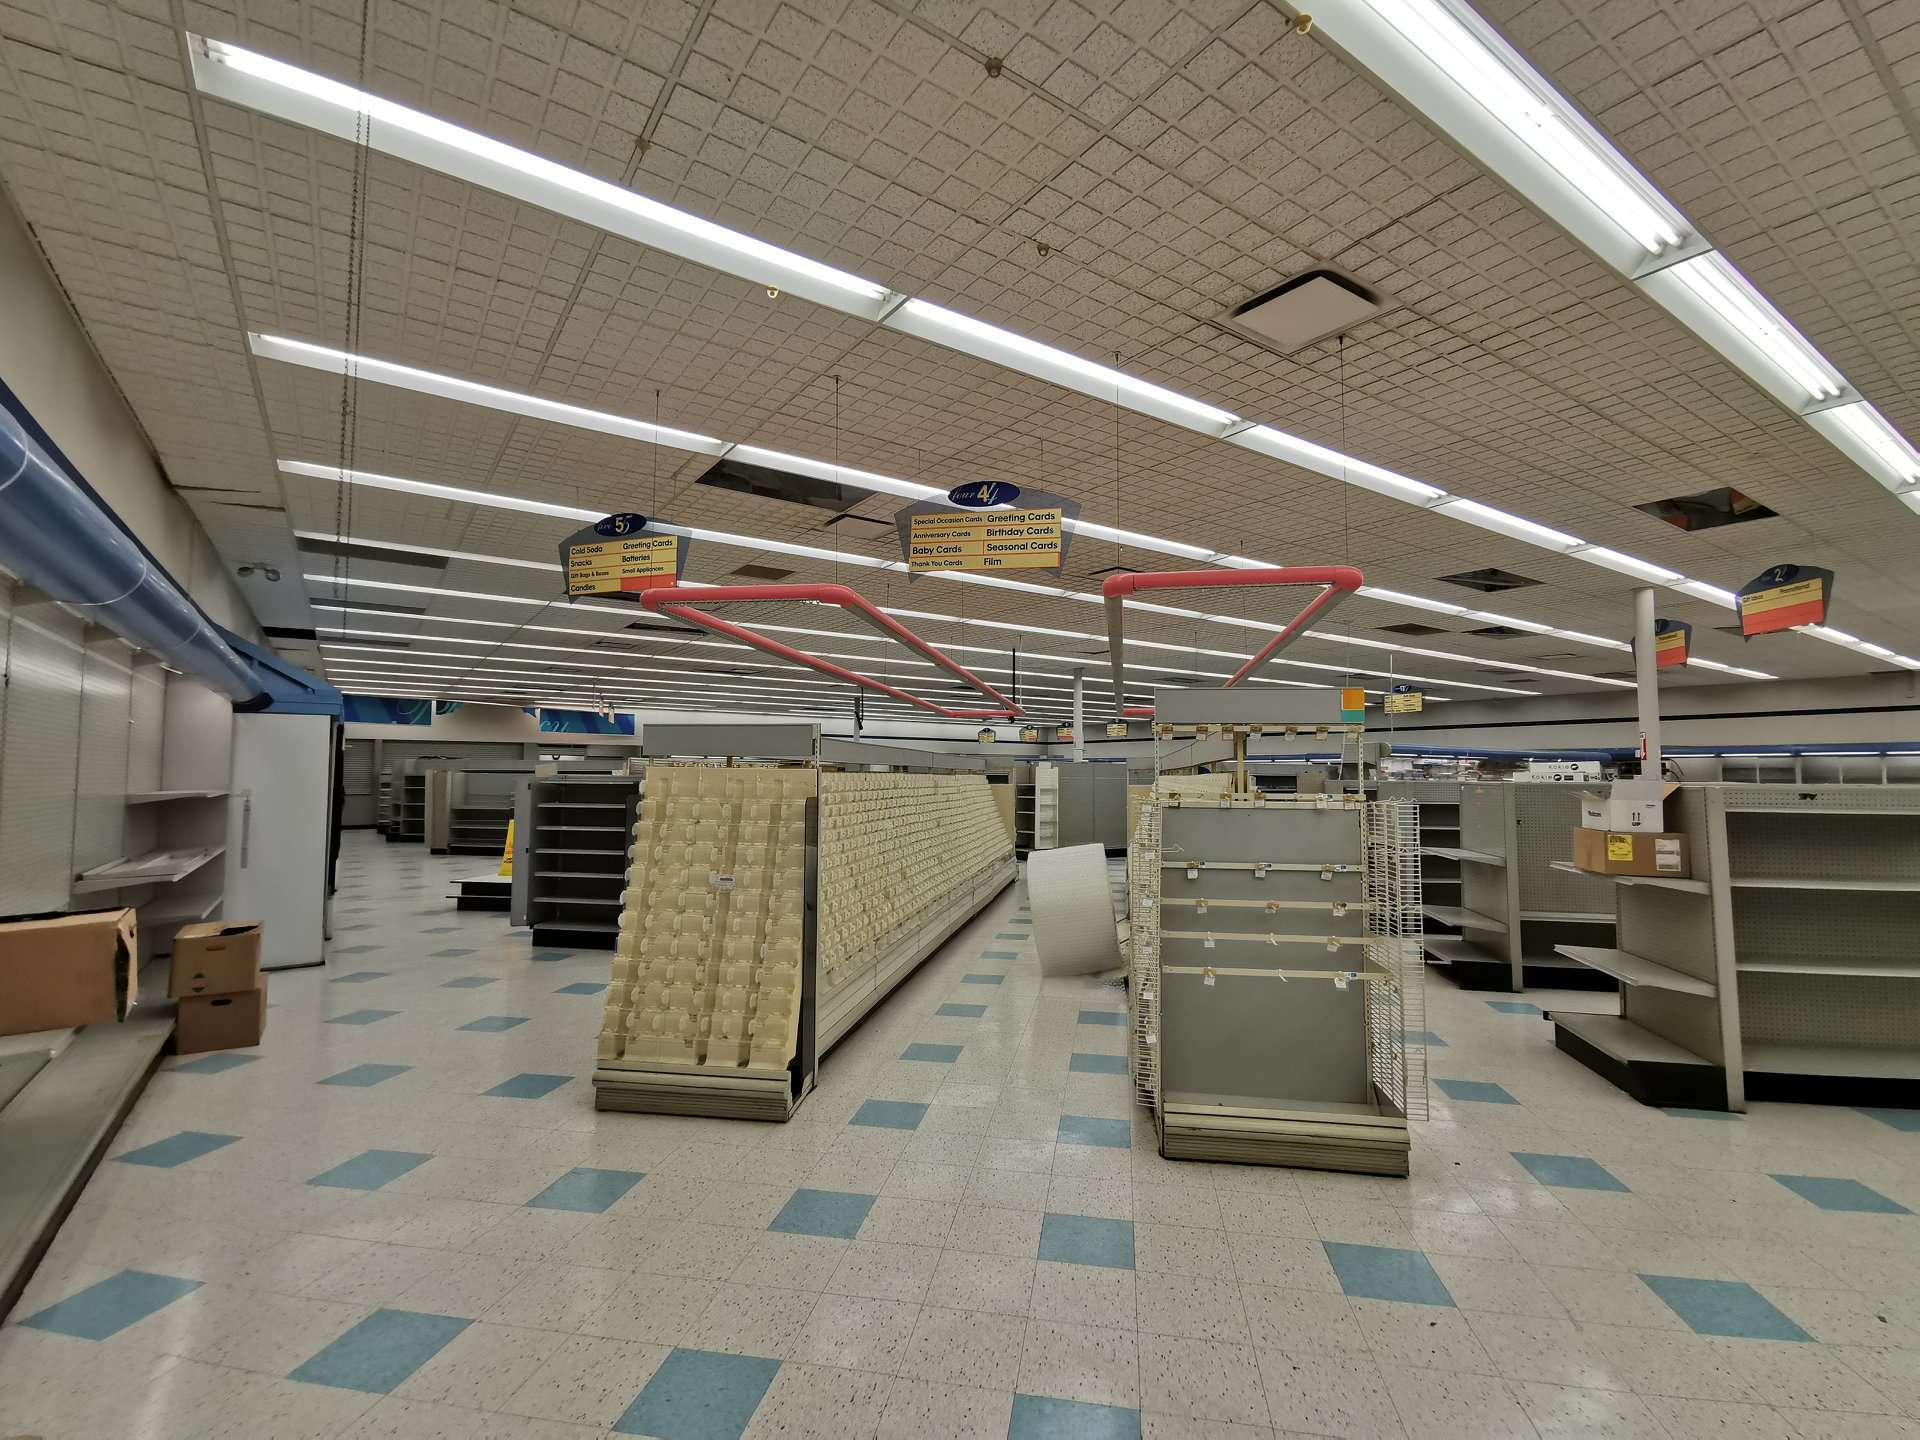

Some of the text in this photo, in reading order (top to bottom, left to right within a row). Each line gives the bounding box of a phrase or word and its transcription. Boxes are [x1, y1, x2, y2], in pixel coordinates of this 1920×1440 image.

[937, 516, 964, 524] Occasion
[965, 515, 983, 523] Cards
[987, 512, 1055, 523] Greeting Cards
[913, 530, 971, 539] Anniversary Cards
[986, 526, 1054, 537] Birthday Cards
[623, 538, 673, 550] Greeting Cards
[987, 541, 1058, 552] Seasonal Cards
[571, 545, 603, 555] Cold Soda
[913, 545, 962, 555] Baby Cards
[570, 559, 592, 568] Snacks
[622, 555, 650, 563] Batteries
[944, 559, 963, 567] Cards
[983, 558, 1002, 566] Film
[622, 566, 664, 575] Small Appliances
[570, 583, 596, 592] Candles
